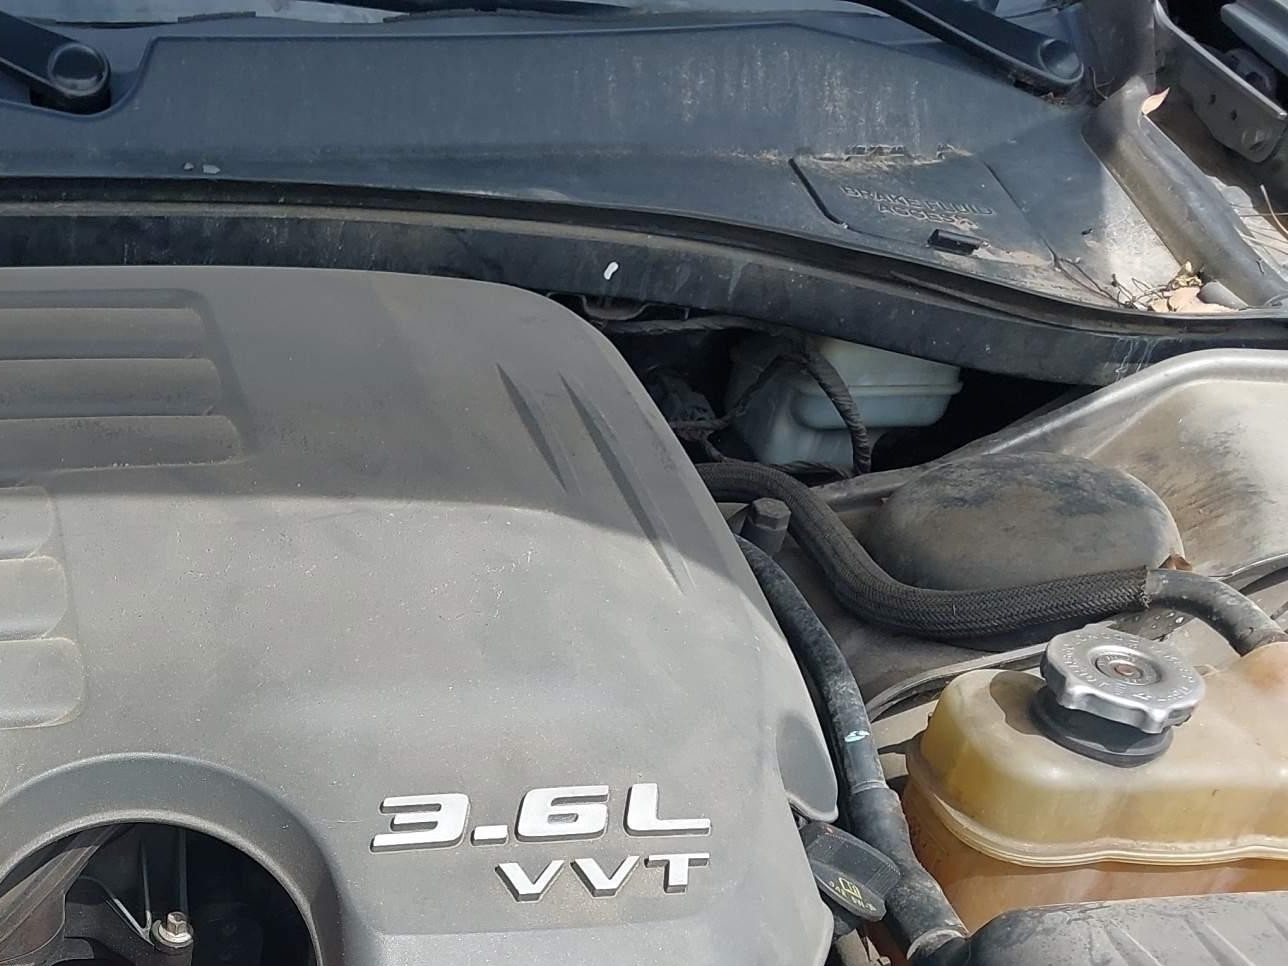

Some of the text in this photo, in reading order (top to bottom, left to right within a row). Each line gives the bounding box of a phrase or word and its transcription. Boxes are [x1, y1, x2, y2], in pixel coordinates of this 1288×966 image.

[841, 186, 993, 216] BRAKE FLUID
[370, 783, 711, 853] 3.6L
[495, 853, 710, 902] VVT
